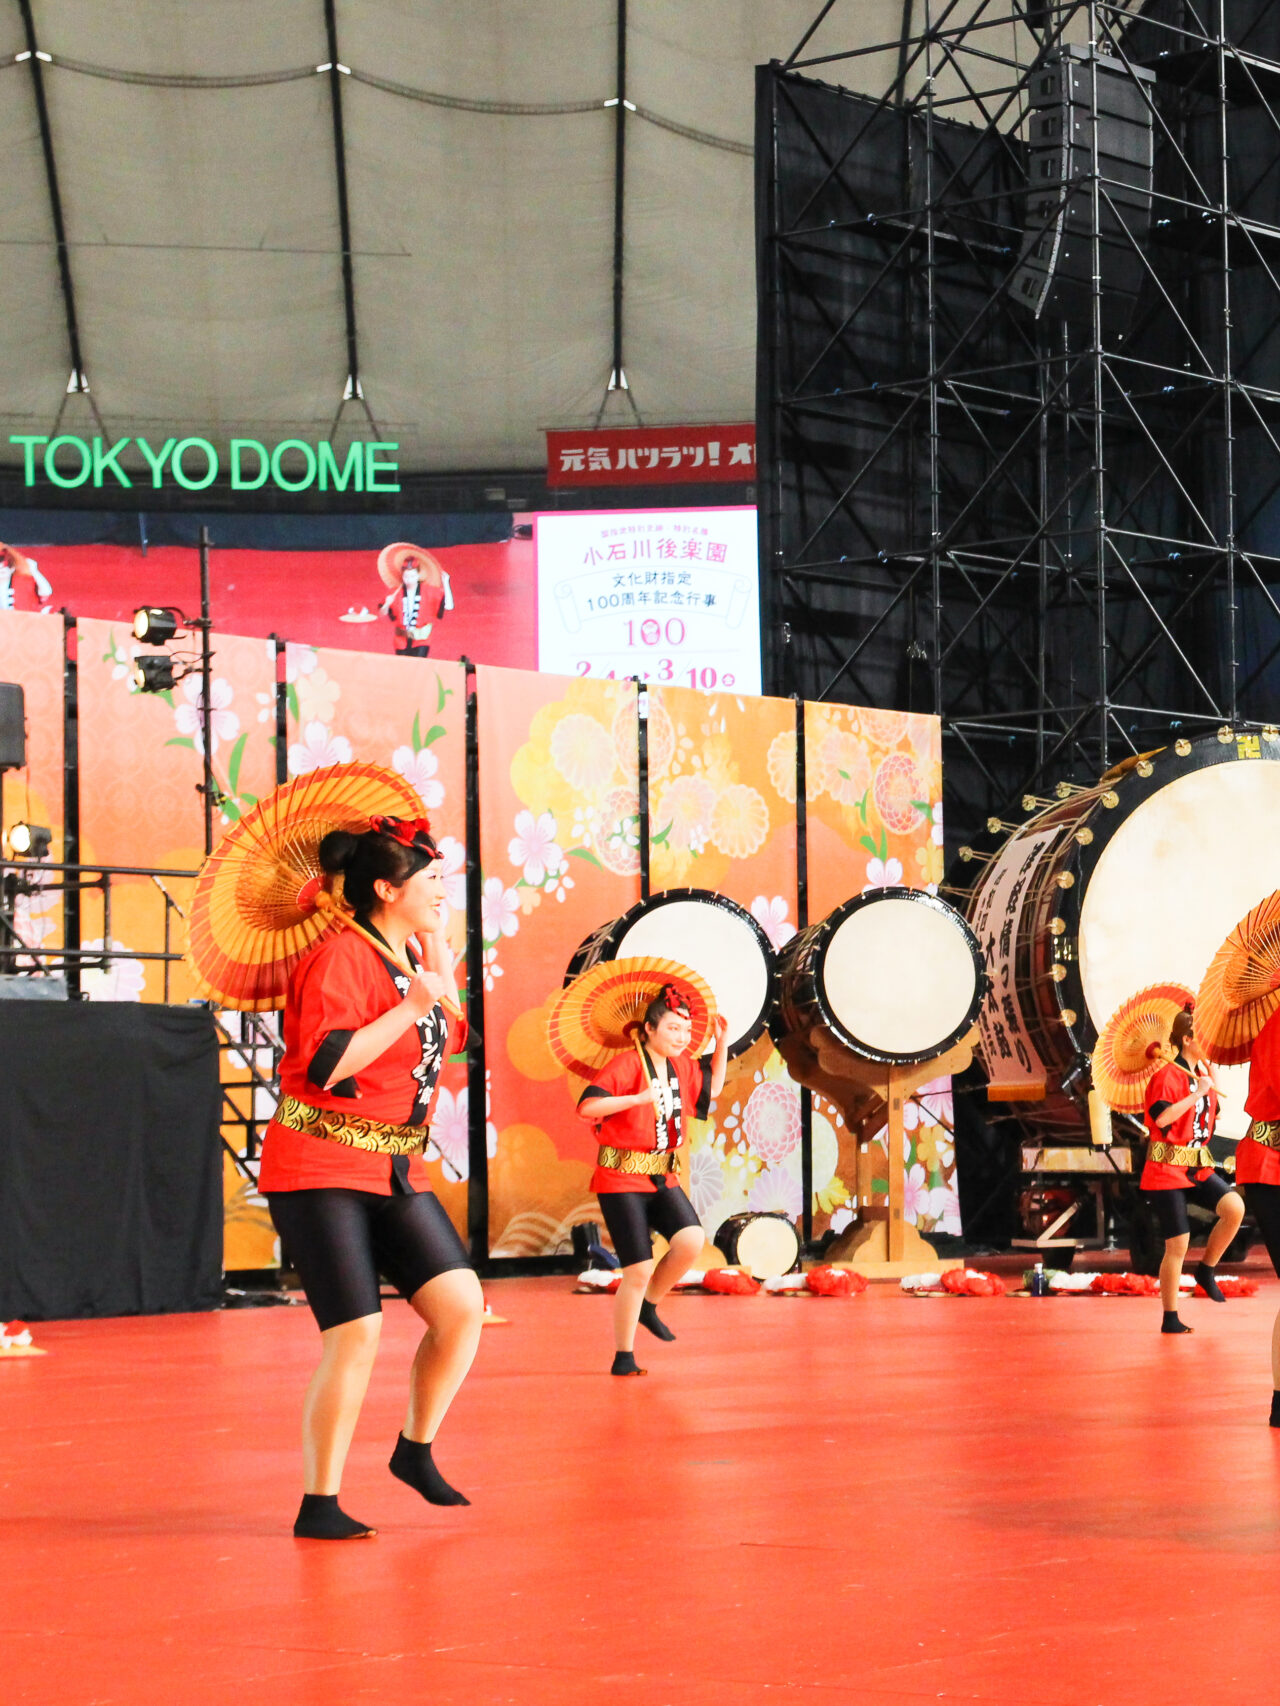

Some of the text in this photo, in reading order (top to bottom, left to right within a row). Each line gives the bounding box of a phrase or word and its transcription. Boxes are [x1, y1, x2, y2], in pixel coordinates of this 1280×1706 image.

[9, 435, 401, 493] TOKYO DOME
[559, 441, 757, 472] 元気ハツラツ!オ
[583, 537, 728, 567] 小石川後楽園
[612, 571, 693, 588] 文化財指定
[587, 590, 718, 612] 100周年記念行事
